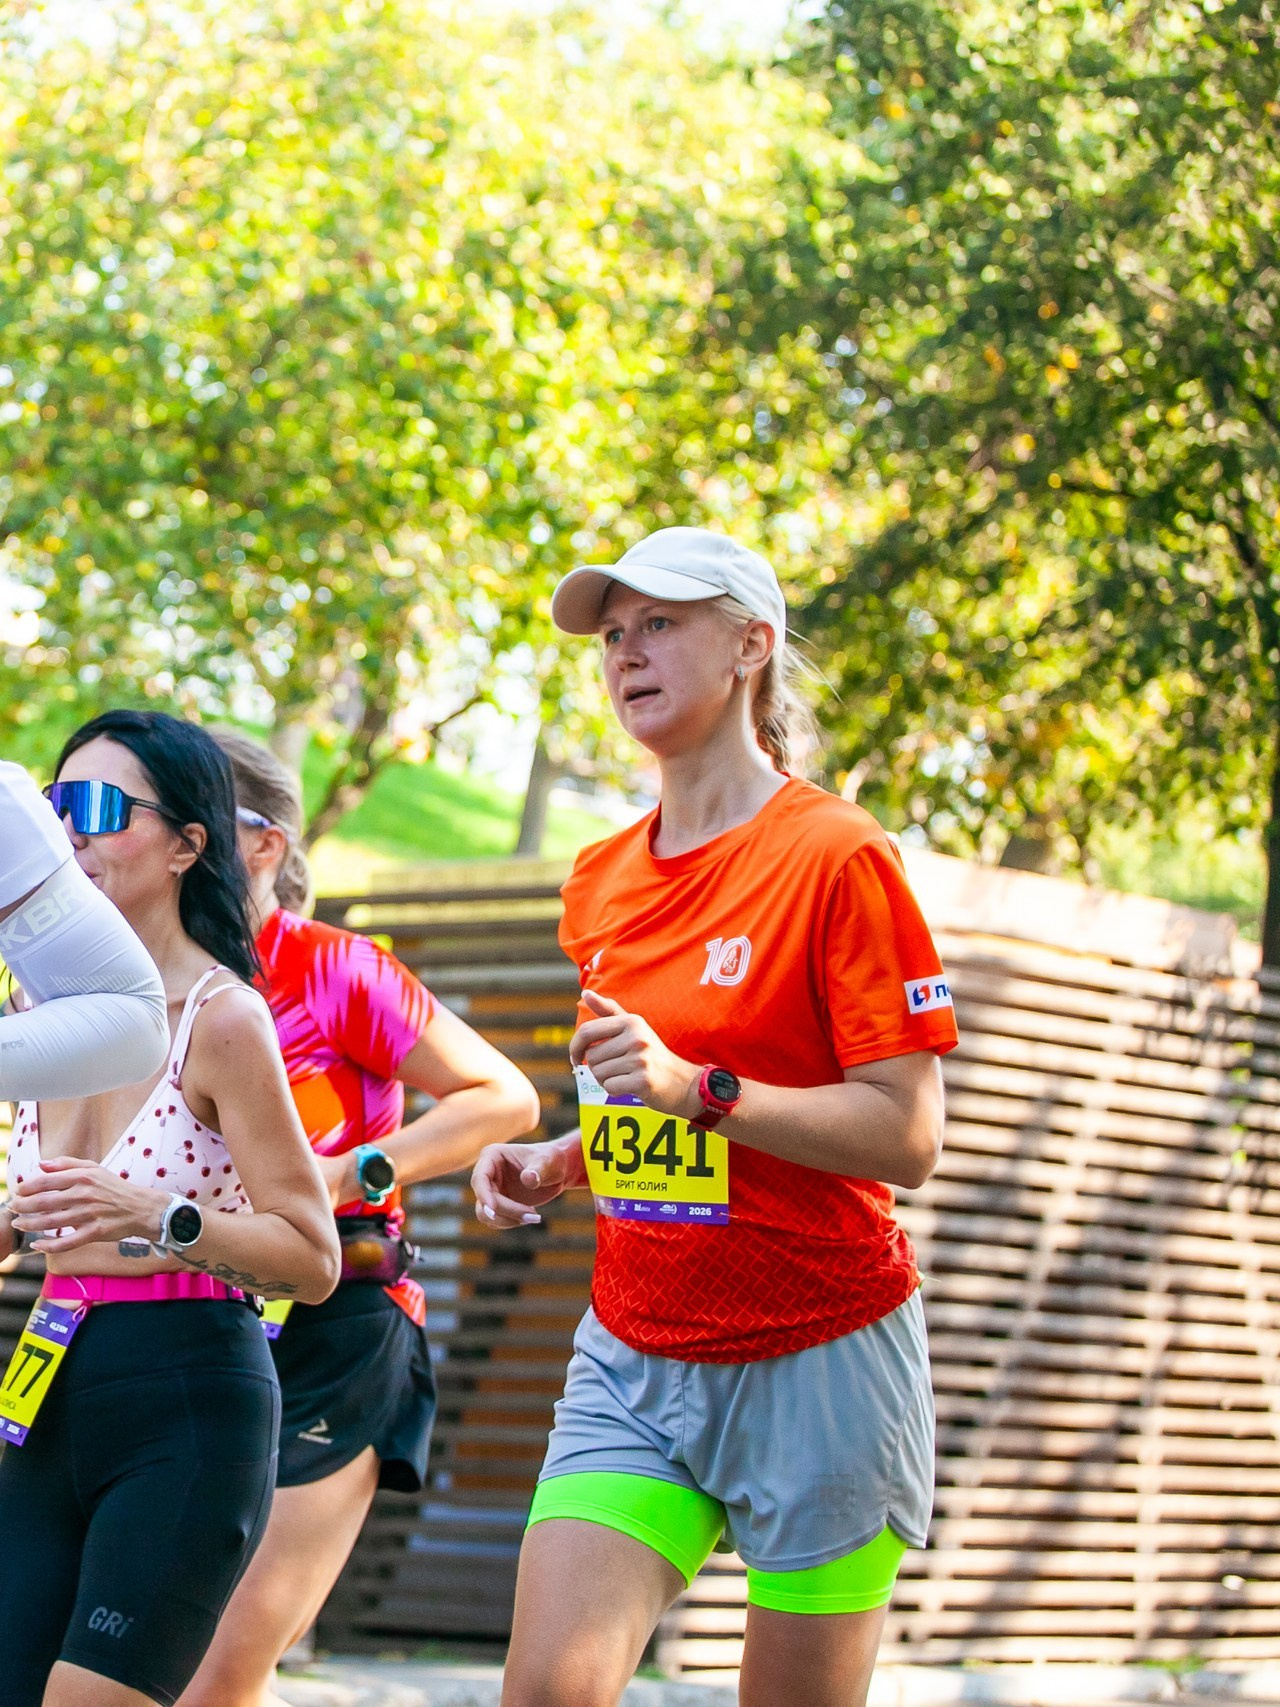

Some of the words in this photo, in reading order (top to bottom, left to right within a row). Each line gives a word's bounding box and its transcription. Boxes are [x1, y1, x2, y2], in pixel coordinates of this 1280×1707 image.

[700, 935, 752, 986] 10
[935, 984, 951, 998] П
[589, 1115, 715, 1178] 4341
[616, 1180, 635, 1190] БРИТ
[637, 1181, 668, 1192] ЮЛИЯ
[688, 1206, 712, 1216] 2026
